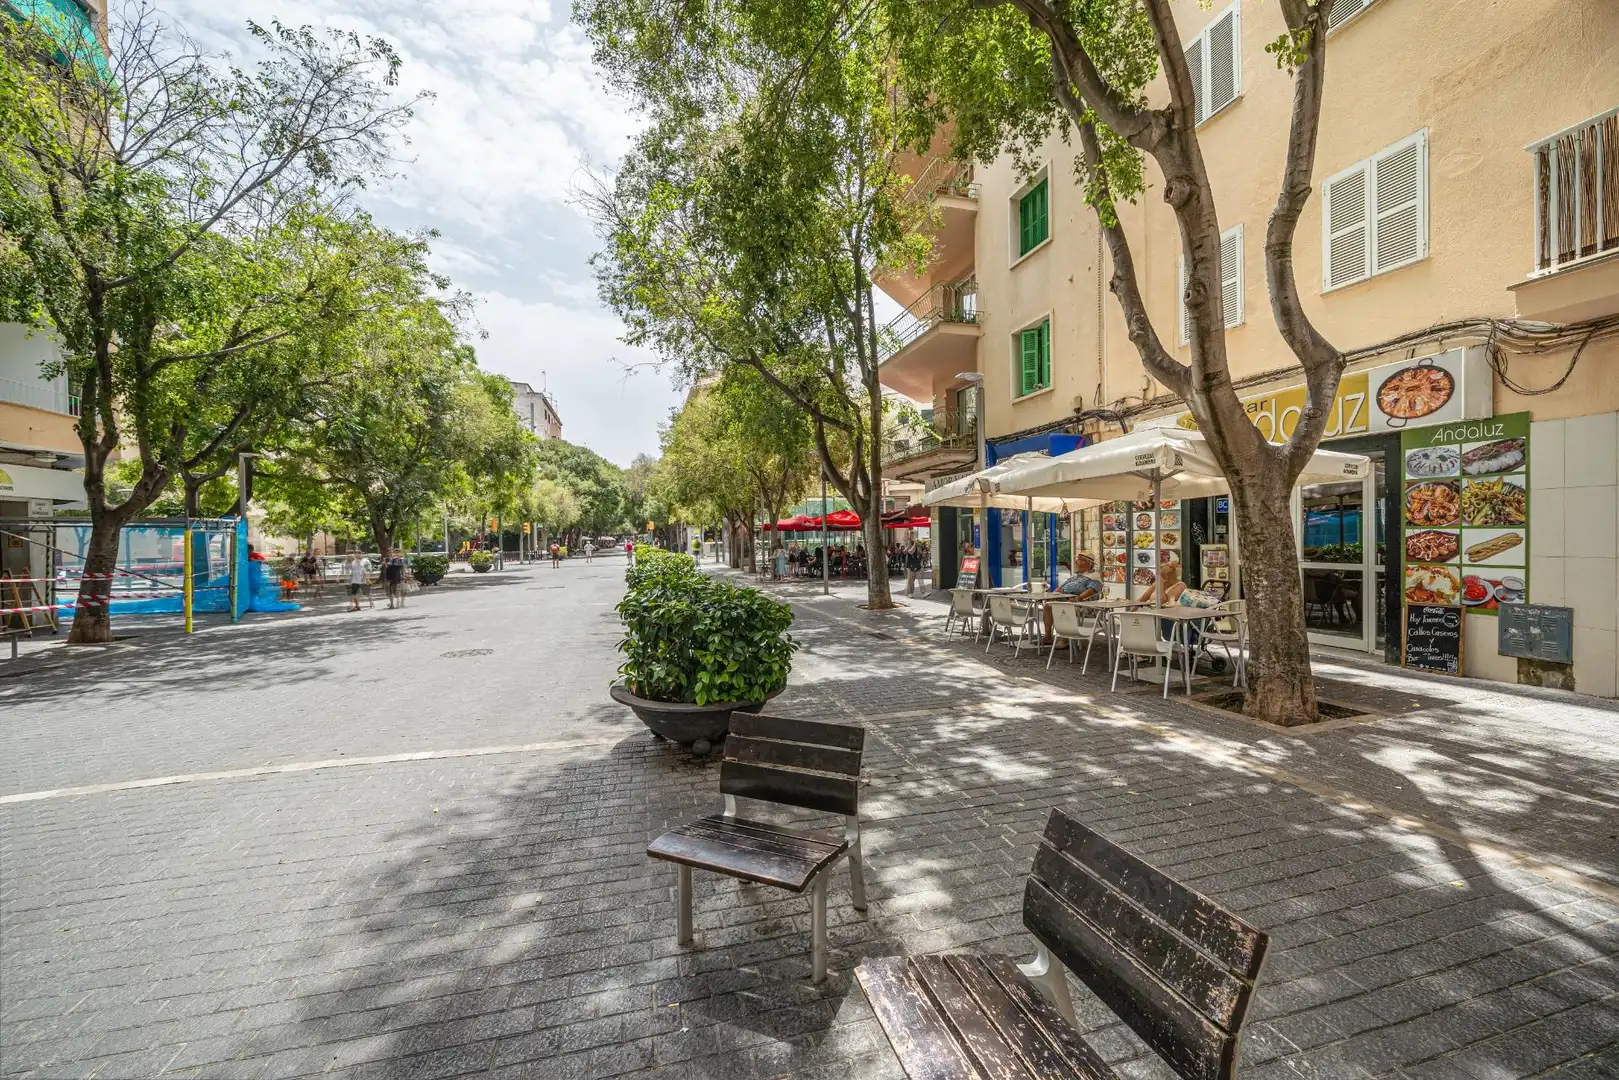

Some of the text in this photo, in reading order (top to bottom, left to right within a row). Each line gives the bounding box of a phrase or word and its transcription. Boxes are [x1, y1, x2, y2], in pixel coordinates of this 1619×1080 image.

[1242, 400, 1267, 414] ar
[1431, 422, 1504, 443] Andaluz
[1217, 500, 1228, 509] BC
[1409, 613, 1422, 625] Hoy
[1408, 626, 1431, 636] Callos
